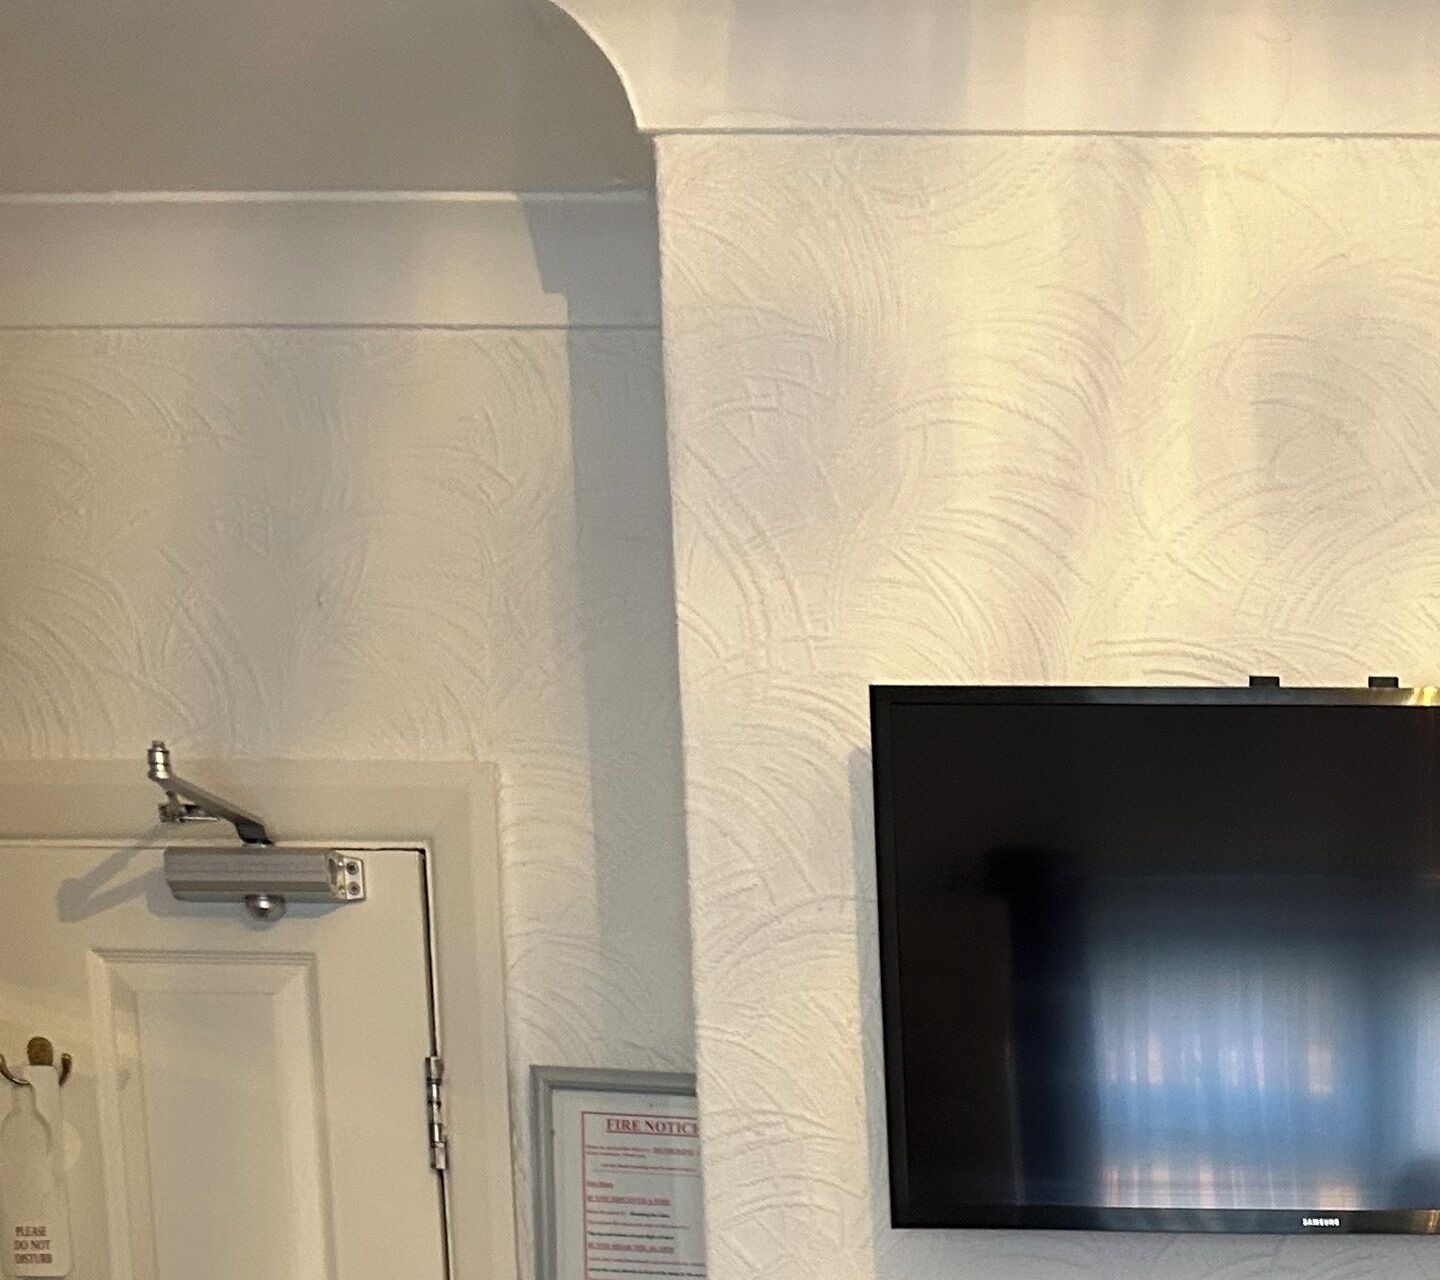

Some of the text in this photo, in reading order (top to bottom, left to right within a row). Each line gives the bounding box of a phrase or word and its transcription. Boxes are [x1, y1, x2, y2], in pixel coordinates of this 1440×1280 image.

[606, 1119, 641, 1132] FIRE
[15, 1226, 47, 1236] PLEASE
[14, 1240, 50, 1250] DO NOT
[14, 1253, 53, 1264] DISTURB
